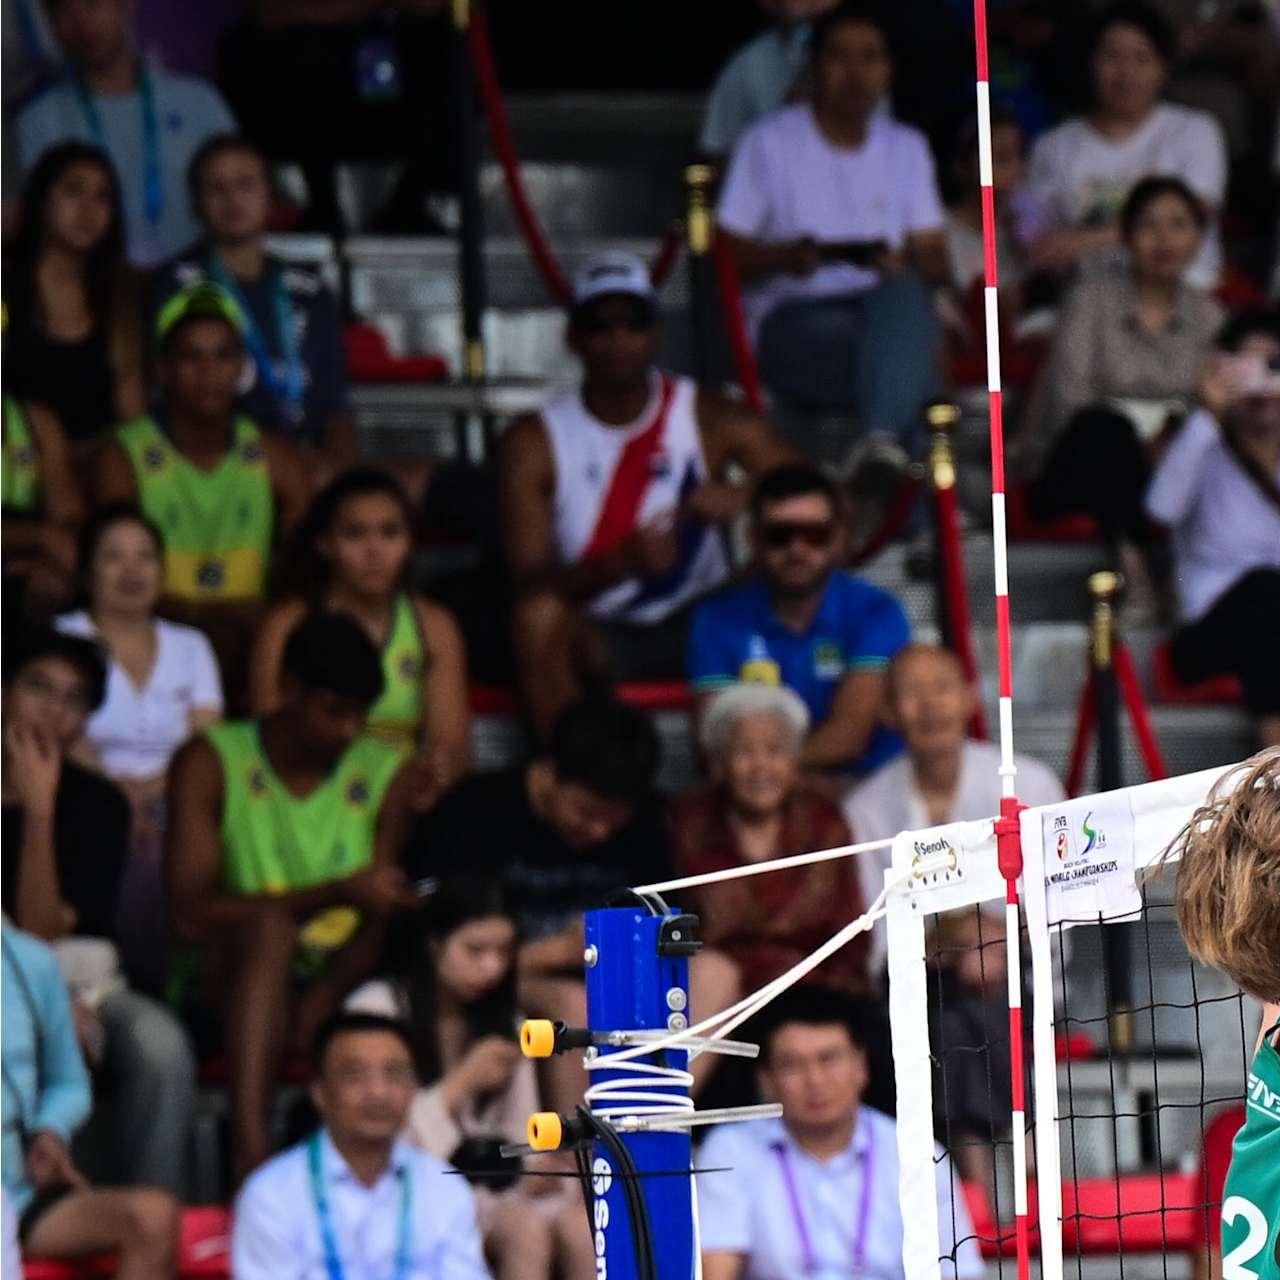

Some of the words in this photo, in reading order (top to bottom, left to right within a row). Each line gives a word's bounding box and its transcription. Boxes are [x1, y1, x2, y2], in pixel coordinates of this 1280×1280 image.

[1054, 815, 1067, 830] FIVB
[920, 836, 950, 856] Senoh
[1051, 868, 1071, 884] WORLD
[1071, 860, 1118, 880] CHAMPIONSHIPS
